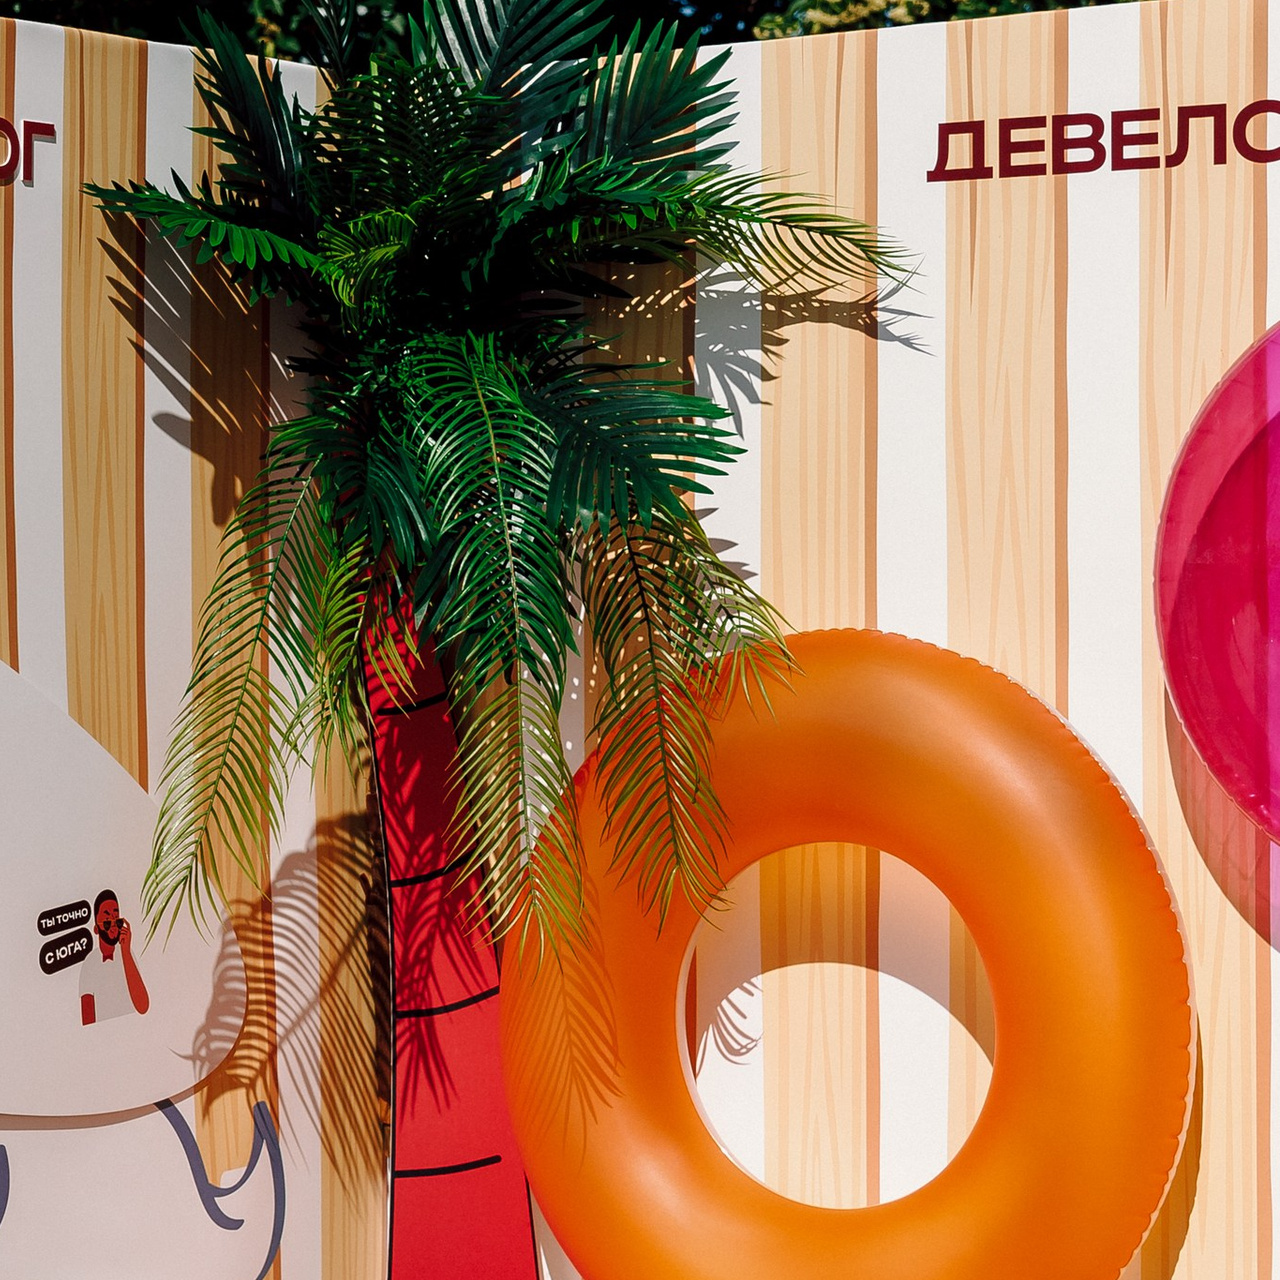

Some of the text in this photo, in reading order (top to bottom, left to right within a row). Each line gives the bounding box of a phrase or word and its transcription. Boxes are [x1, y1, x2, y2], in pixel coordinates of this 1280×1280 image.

[926, 99, 1280, 183] ДЕВЕЛО
[45, 938, 88, 964] С ЮГА?
